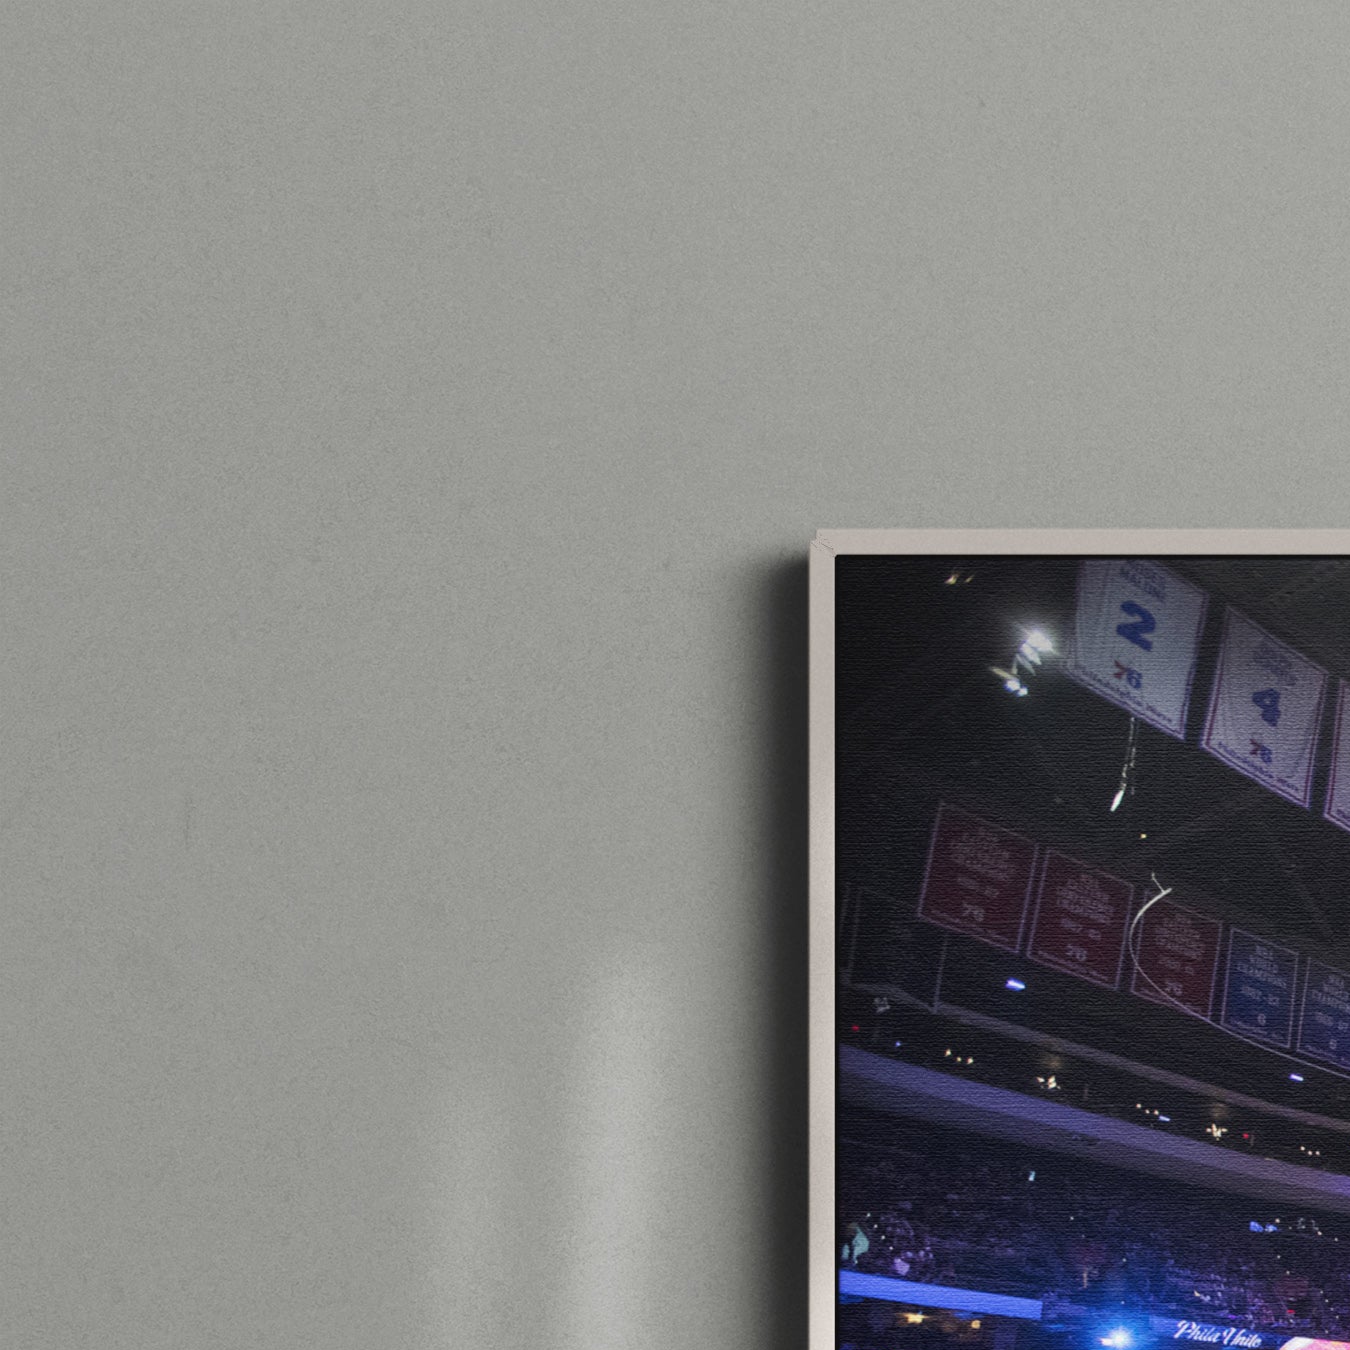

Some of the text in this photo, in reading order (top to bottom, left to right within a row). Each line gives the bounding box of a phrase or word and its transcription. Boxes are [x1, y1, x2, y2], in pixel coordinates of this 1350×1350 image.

[1115, 600, 1156, 651] 2
[1252, 687, 1282, 728] 4
[1173, 1320, 1222, 1343] Phila
